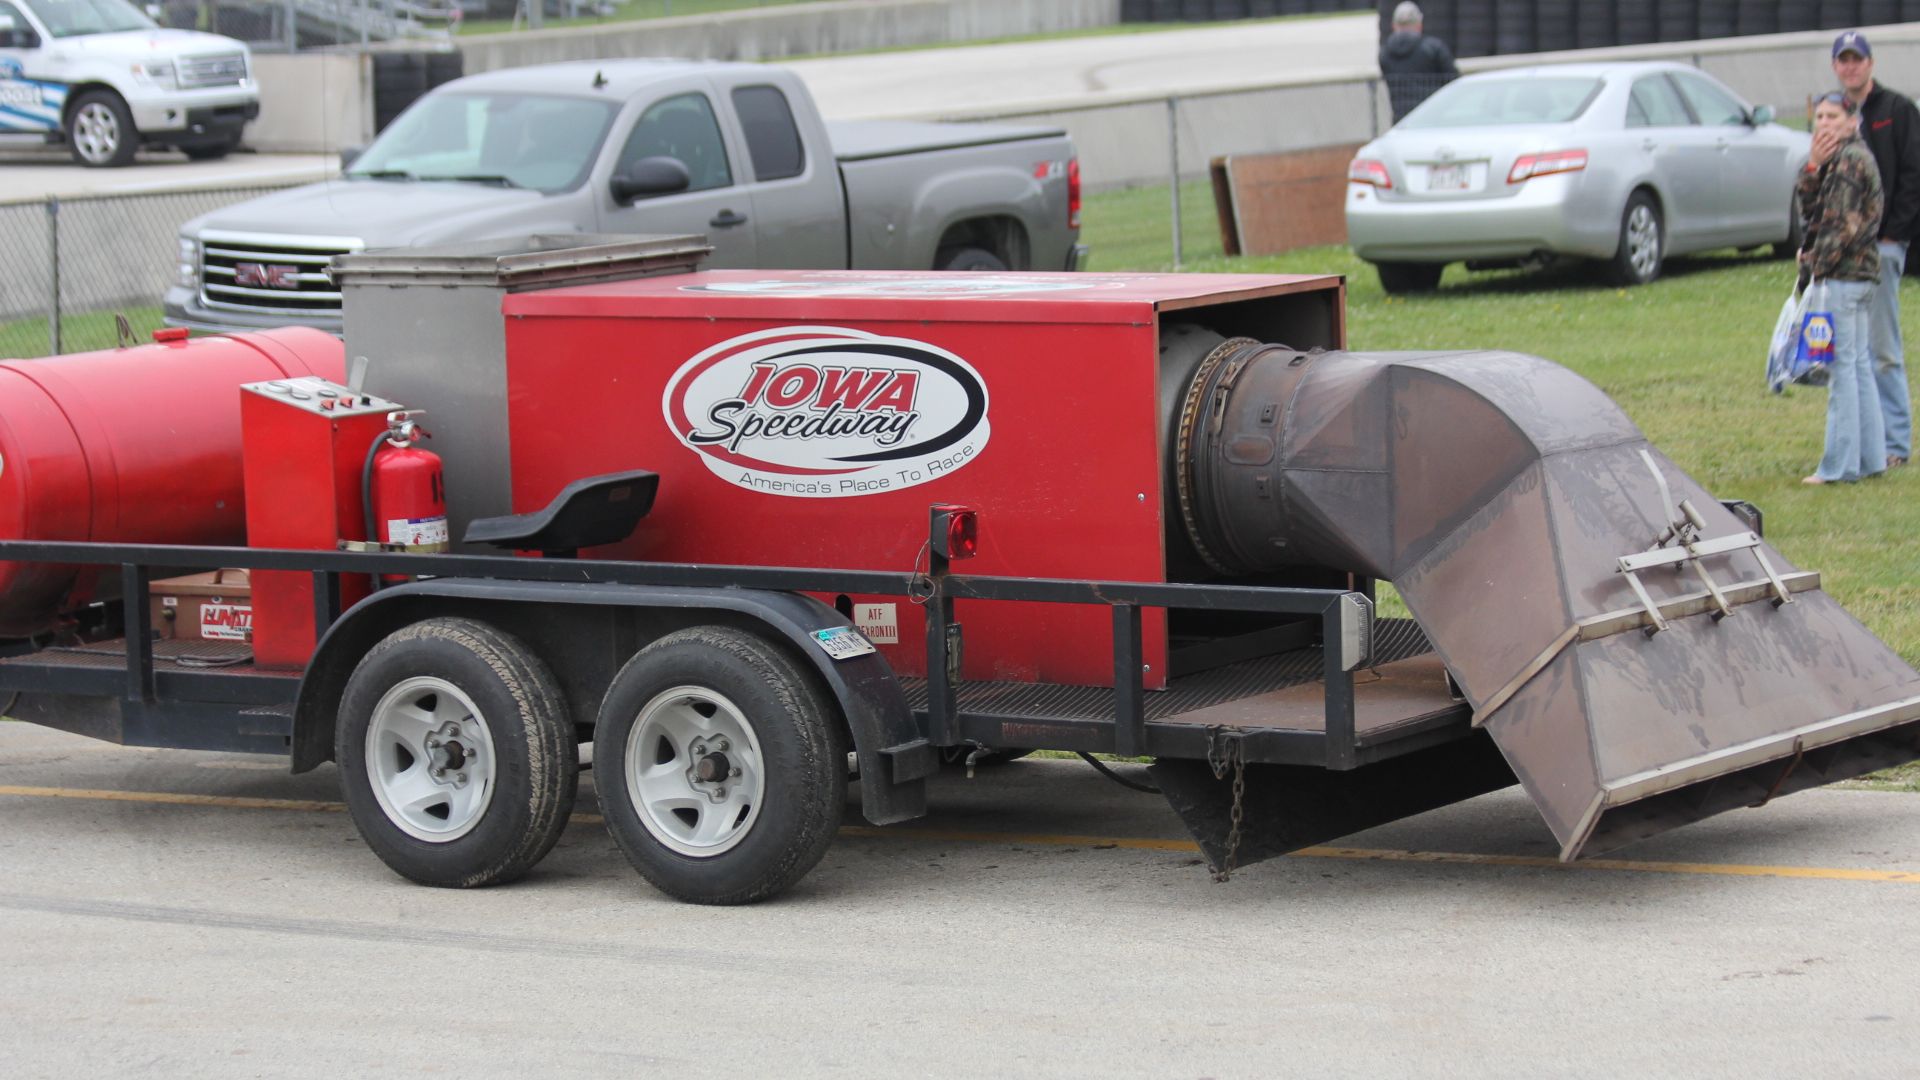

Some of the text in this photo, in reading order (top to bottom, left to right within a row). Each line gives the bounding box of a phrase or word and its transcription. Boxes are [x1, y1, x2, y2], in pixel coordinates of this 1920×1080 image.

[234, 262, 298, 289] GMC
[738, 363, 920, 414] IOWA
[688, 401, 918, 453] Speedway
[739, 446, 972, 494] America's Place To Race
[868, 608, 883, 620] ATF
